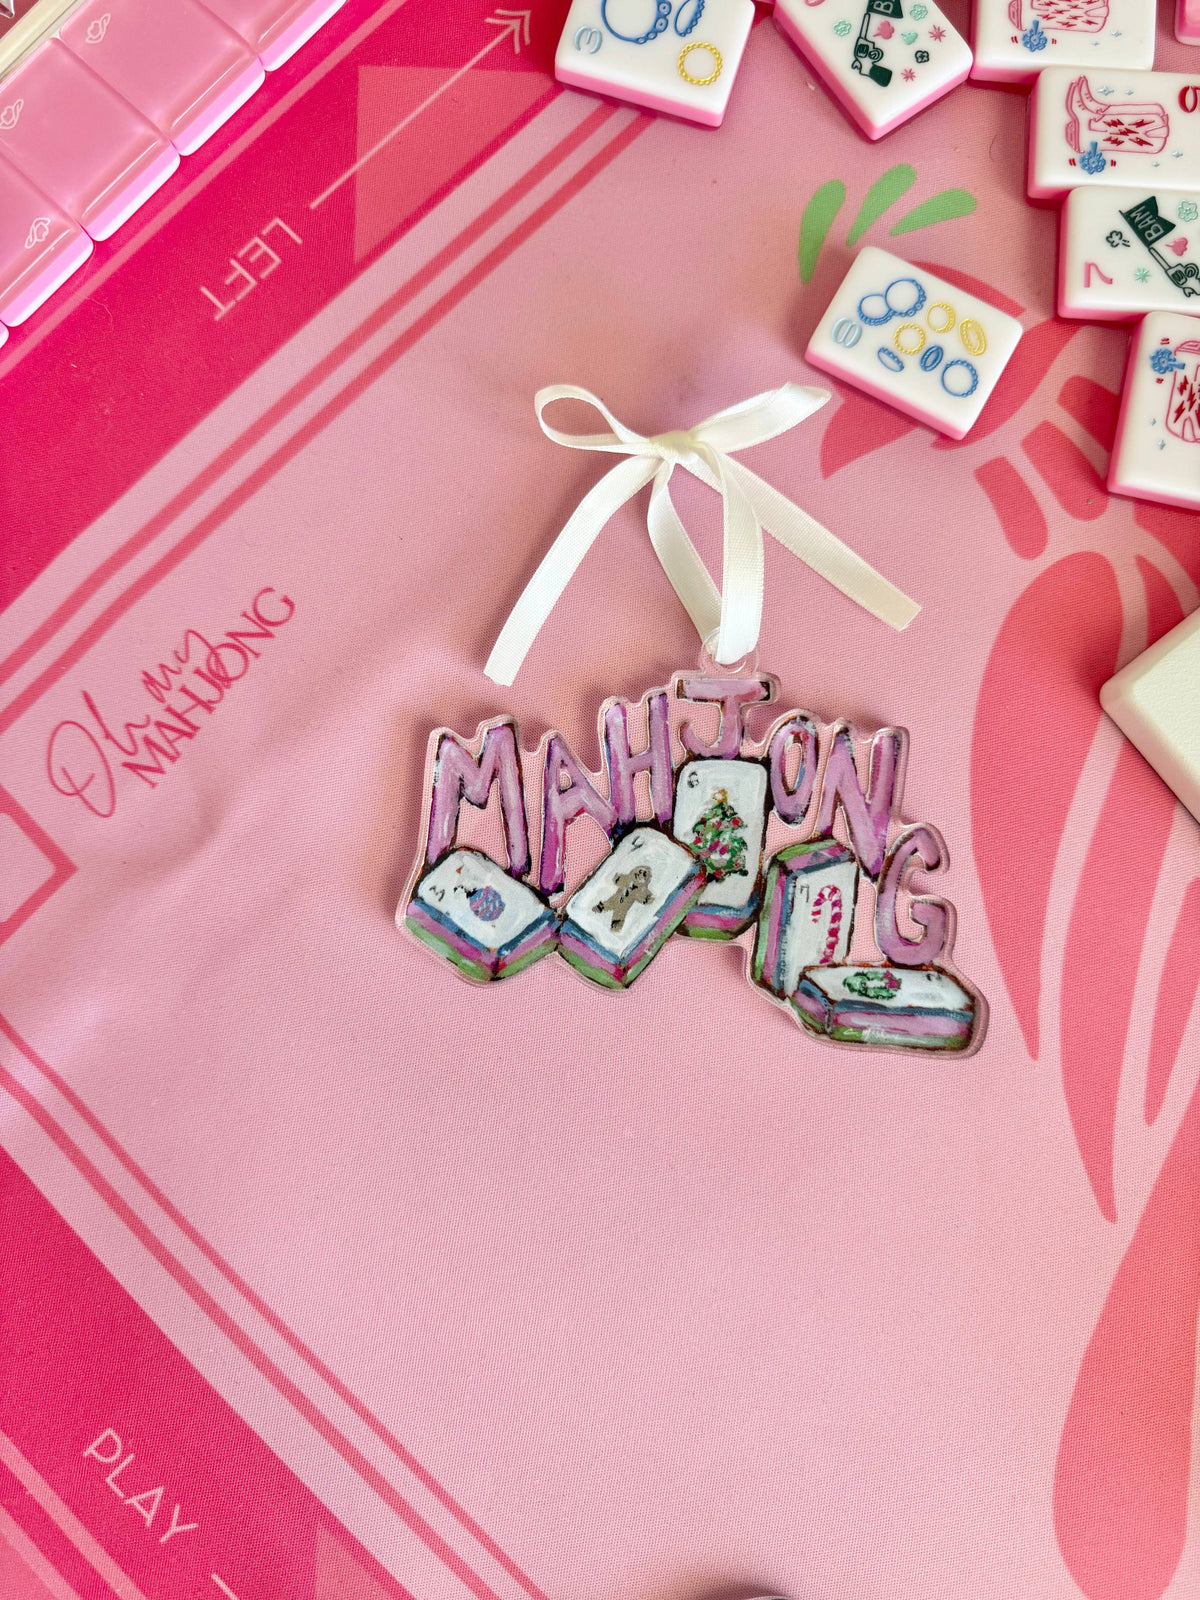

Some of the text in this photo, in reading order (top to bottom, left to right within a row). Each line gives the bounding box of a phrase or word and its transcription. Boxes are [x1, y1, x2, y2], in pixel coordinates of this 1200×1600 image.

[200, 217, 303, 321] LEFT
[1083, 262, 1113, 288] 7
[1129, 204, 1165, 243] BAM
[831, 317, 863, 348] 8
[46, 628, 231, 818] Oh my
[121, 586, 296, 790] MAHJONG
[426, 677, 949, 967] MAHJONG
[83, 1427, 198, 1543] PLAY
